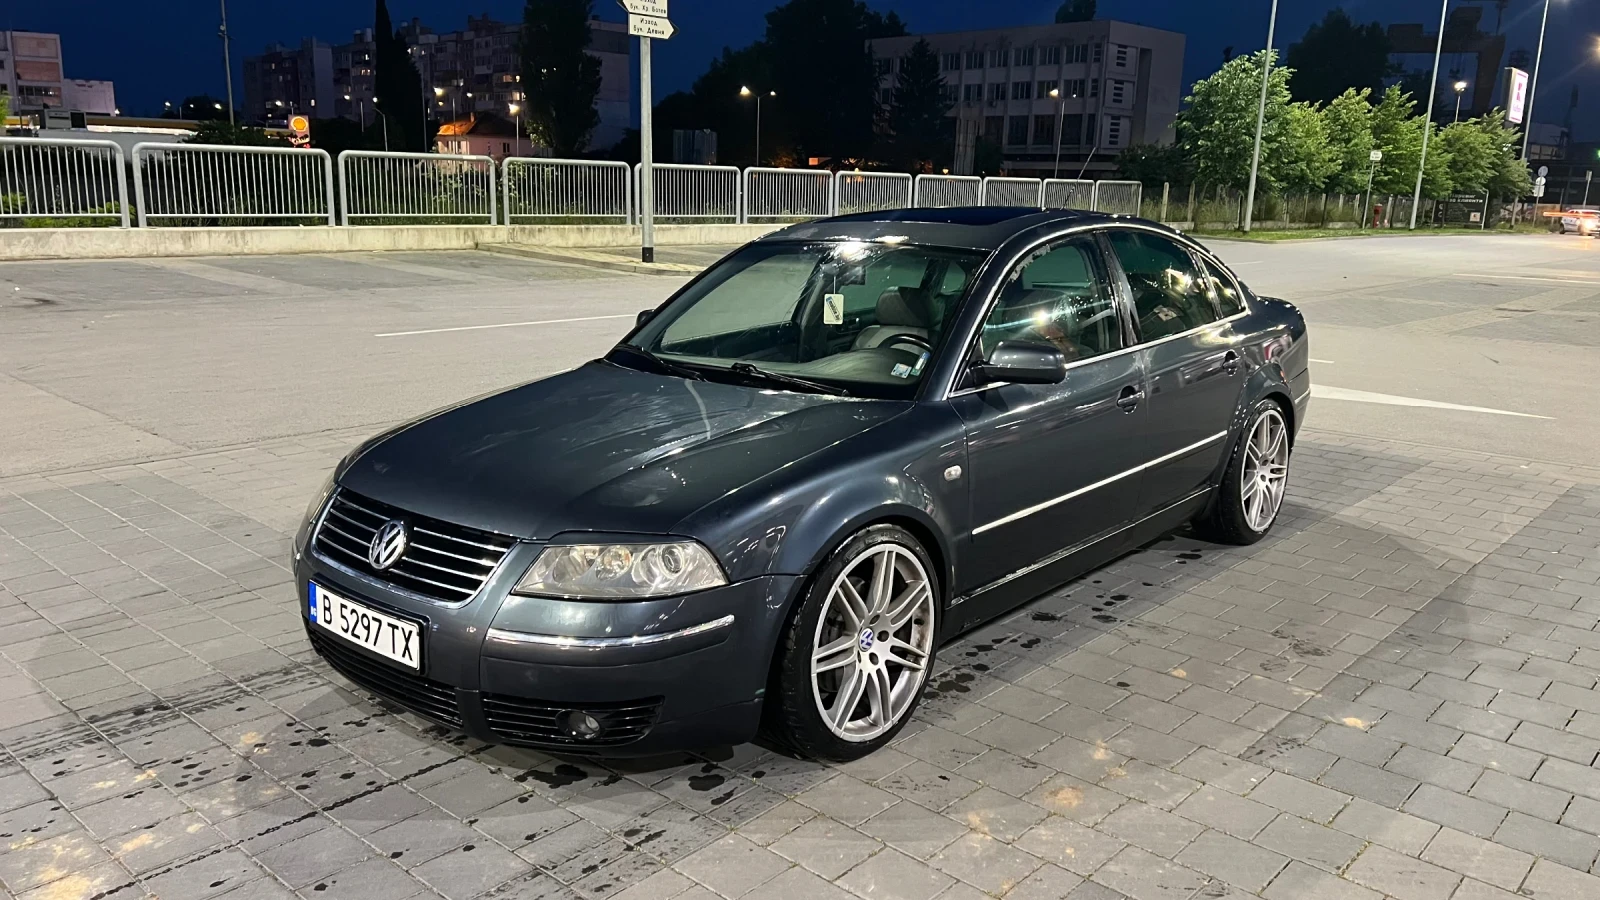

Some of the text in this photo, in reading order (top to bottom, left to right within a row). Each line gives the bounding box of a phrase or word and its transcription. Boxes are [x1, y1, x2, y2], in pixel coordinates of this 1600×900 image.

[647, 27, 665, 35] Девня
[323, 593, 413, 662] B 5297 TX
